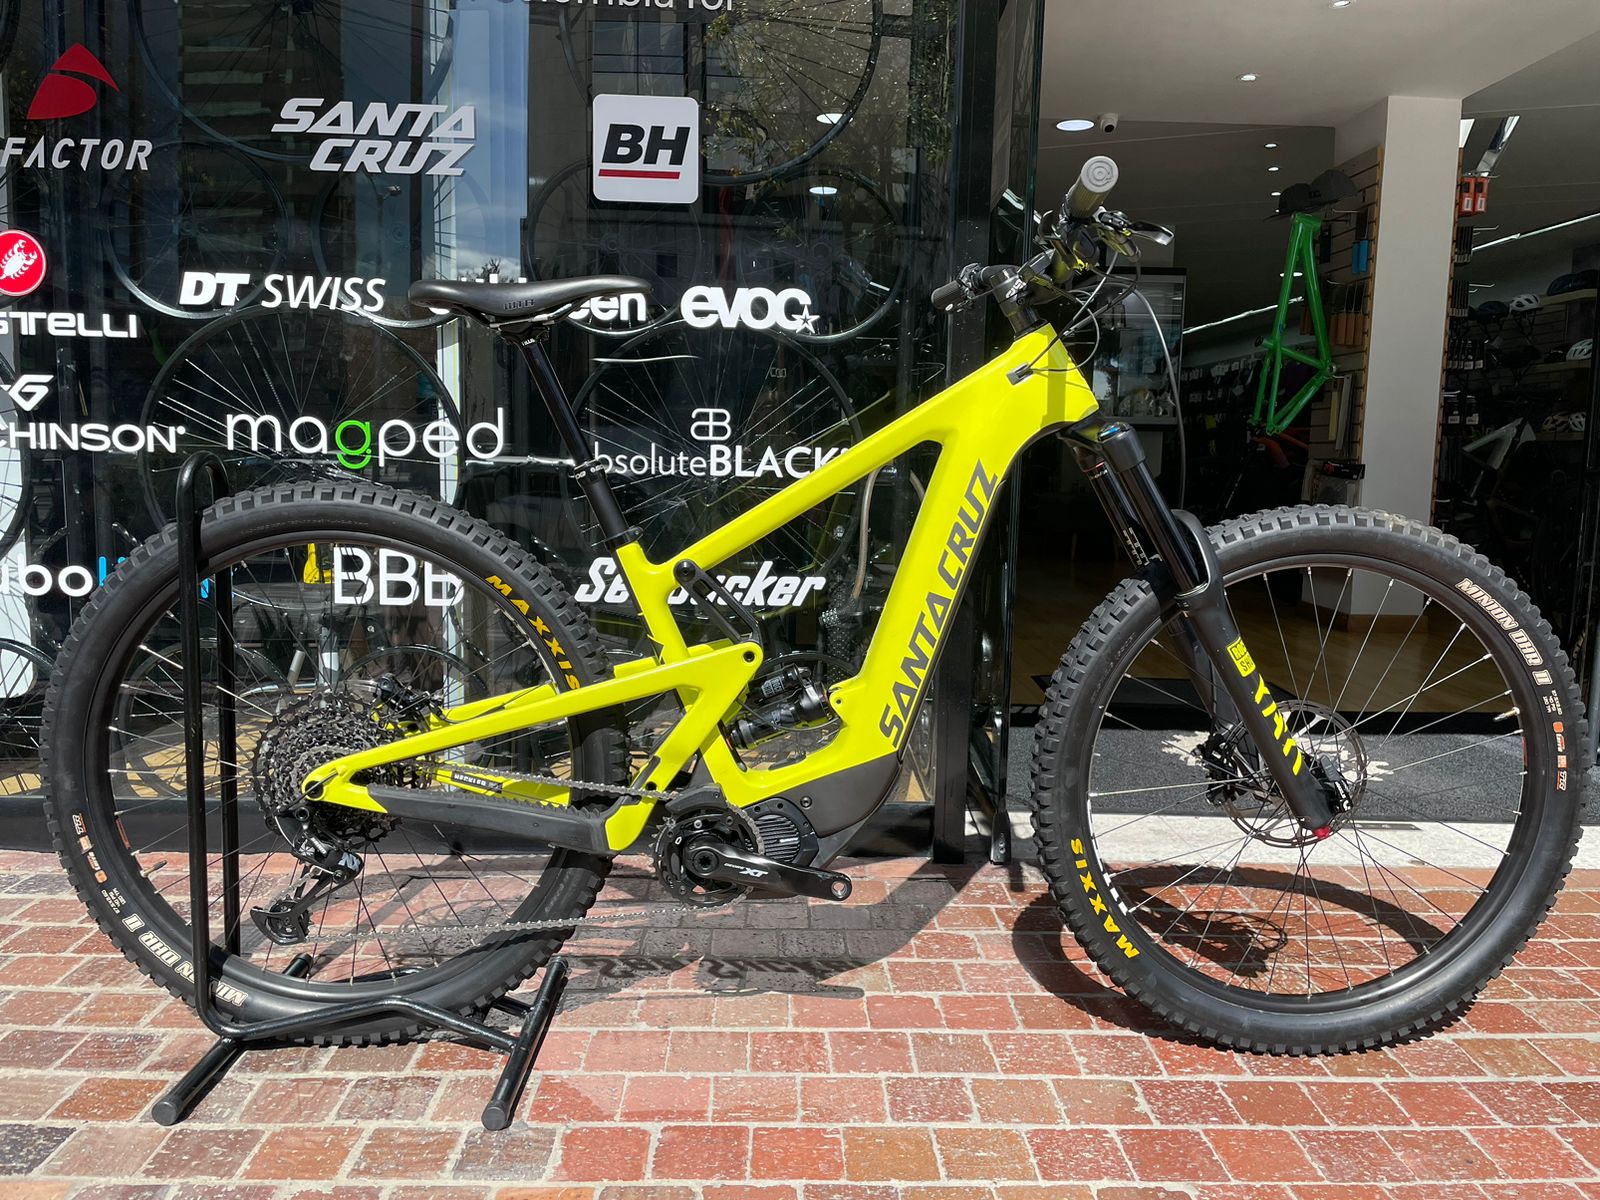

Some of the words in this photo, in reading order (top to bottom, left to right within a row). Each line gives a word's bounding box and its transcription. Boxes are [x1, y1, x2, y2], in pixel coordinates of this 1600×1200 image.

[271, 97, 475, 139] SANTA
[0, 135, 153, 171] FACTOR
[309, 138, 476, 176] CRUZ
[602, 123, 691, 165] BH
[179, 271, 250, 306] DT
[261, 273, 386, 312] SWISS
[225, 407, 504, 469] magped
[594, 441, 840, 480] bsoluteBLACK
[879, 591, 952, 748] SANTA
[937, 457, 998, 591] CRUZ
[1455, 577, 1518, 630] MINION
[1509, 628, 1543, 667] DHR
[485, 575, 581, 690] MAXXIS
[1070, 837, 1140, 959] MAXXIS
[138, 931, 181, 968] DHR
